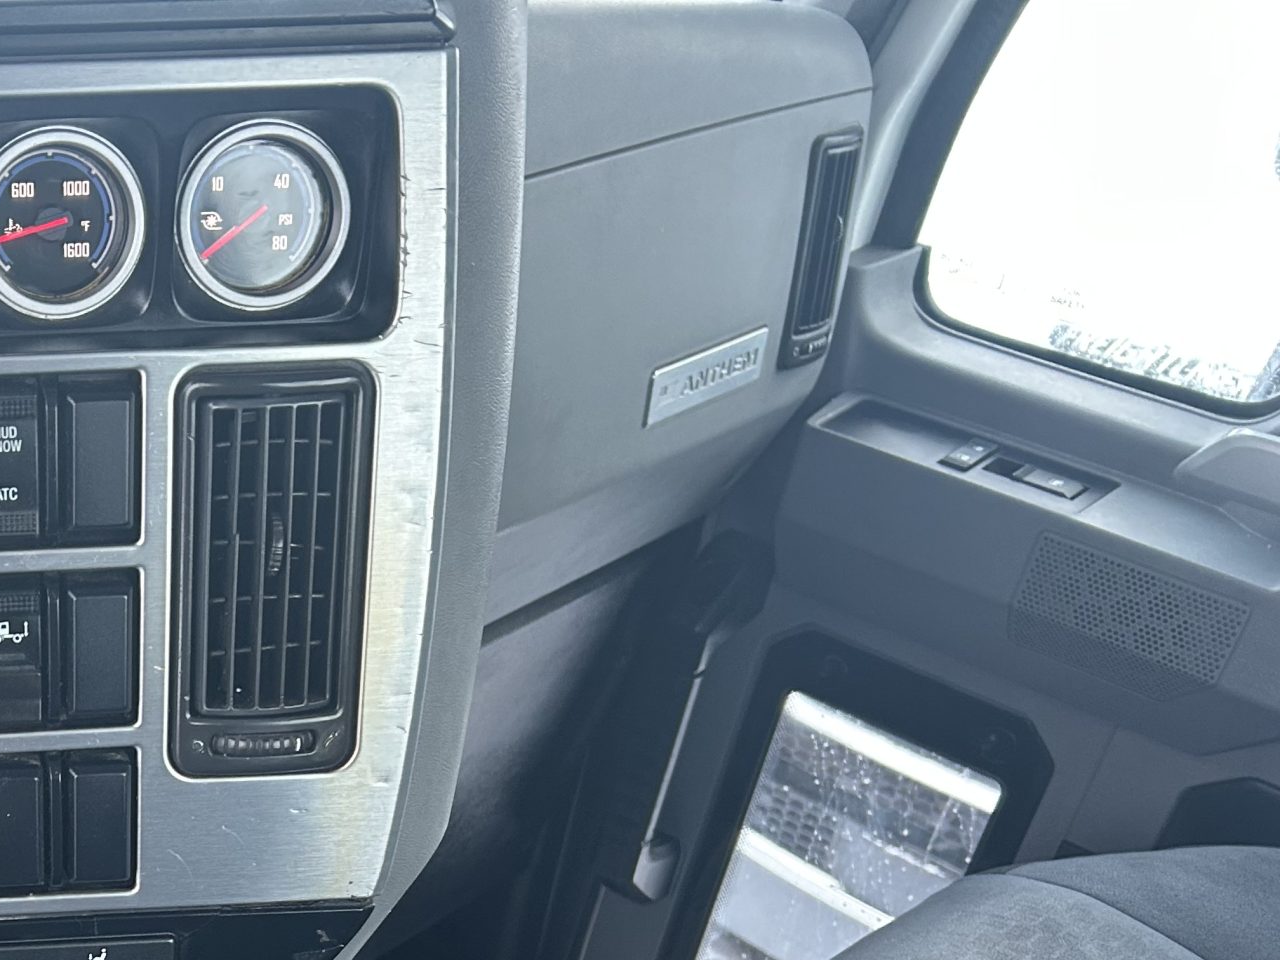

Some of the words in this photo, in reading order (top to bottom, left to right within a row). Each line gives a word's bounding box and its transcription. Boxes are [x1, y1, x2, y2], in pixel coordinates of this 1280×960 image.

[62, 180, 90, 197] 1000
[211, 176, 224, 192] 10
[273, 173, 290, 190] 40
[11, 182, 35, 198] 600
[278, 213, 293, 226] PSI
[63, 242, 90, 258] 1600
[271, 235, 288, 251] 80
